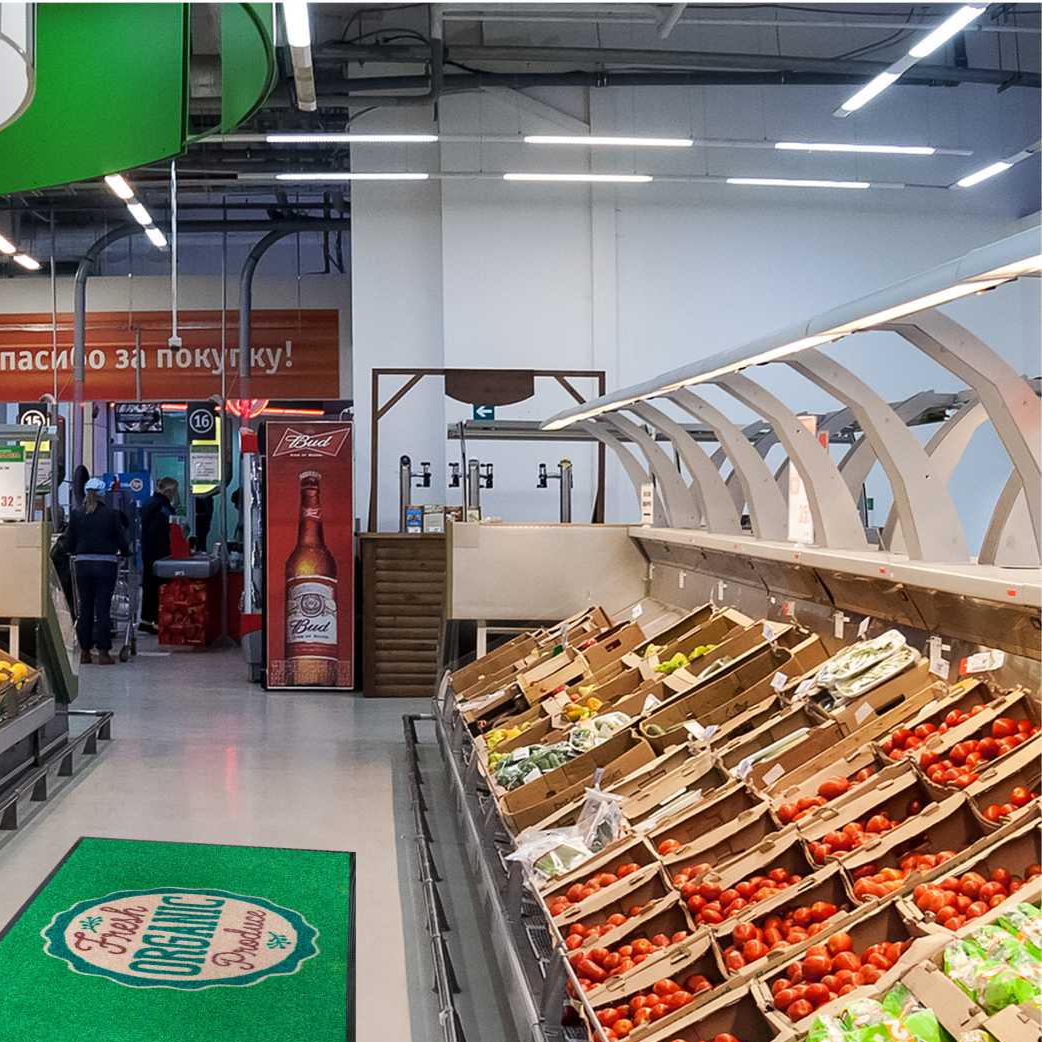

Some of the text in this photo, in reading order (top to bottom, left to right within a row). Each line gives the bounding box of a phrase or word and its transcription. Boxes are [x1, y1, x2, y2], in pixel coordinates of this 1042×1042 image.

[115, 349, 146, 370] за
[194, 414, 210, 428] 16
[285, 434, 333, 449] Bud
[1, 496, 14, 507] 32
[289, 618, 331, 635] Bud
[73, 905, 149, 955] Fresh
[128, 895, 226, 976] ORGANIC
[211, 909, 268, 971] Produce
